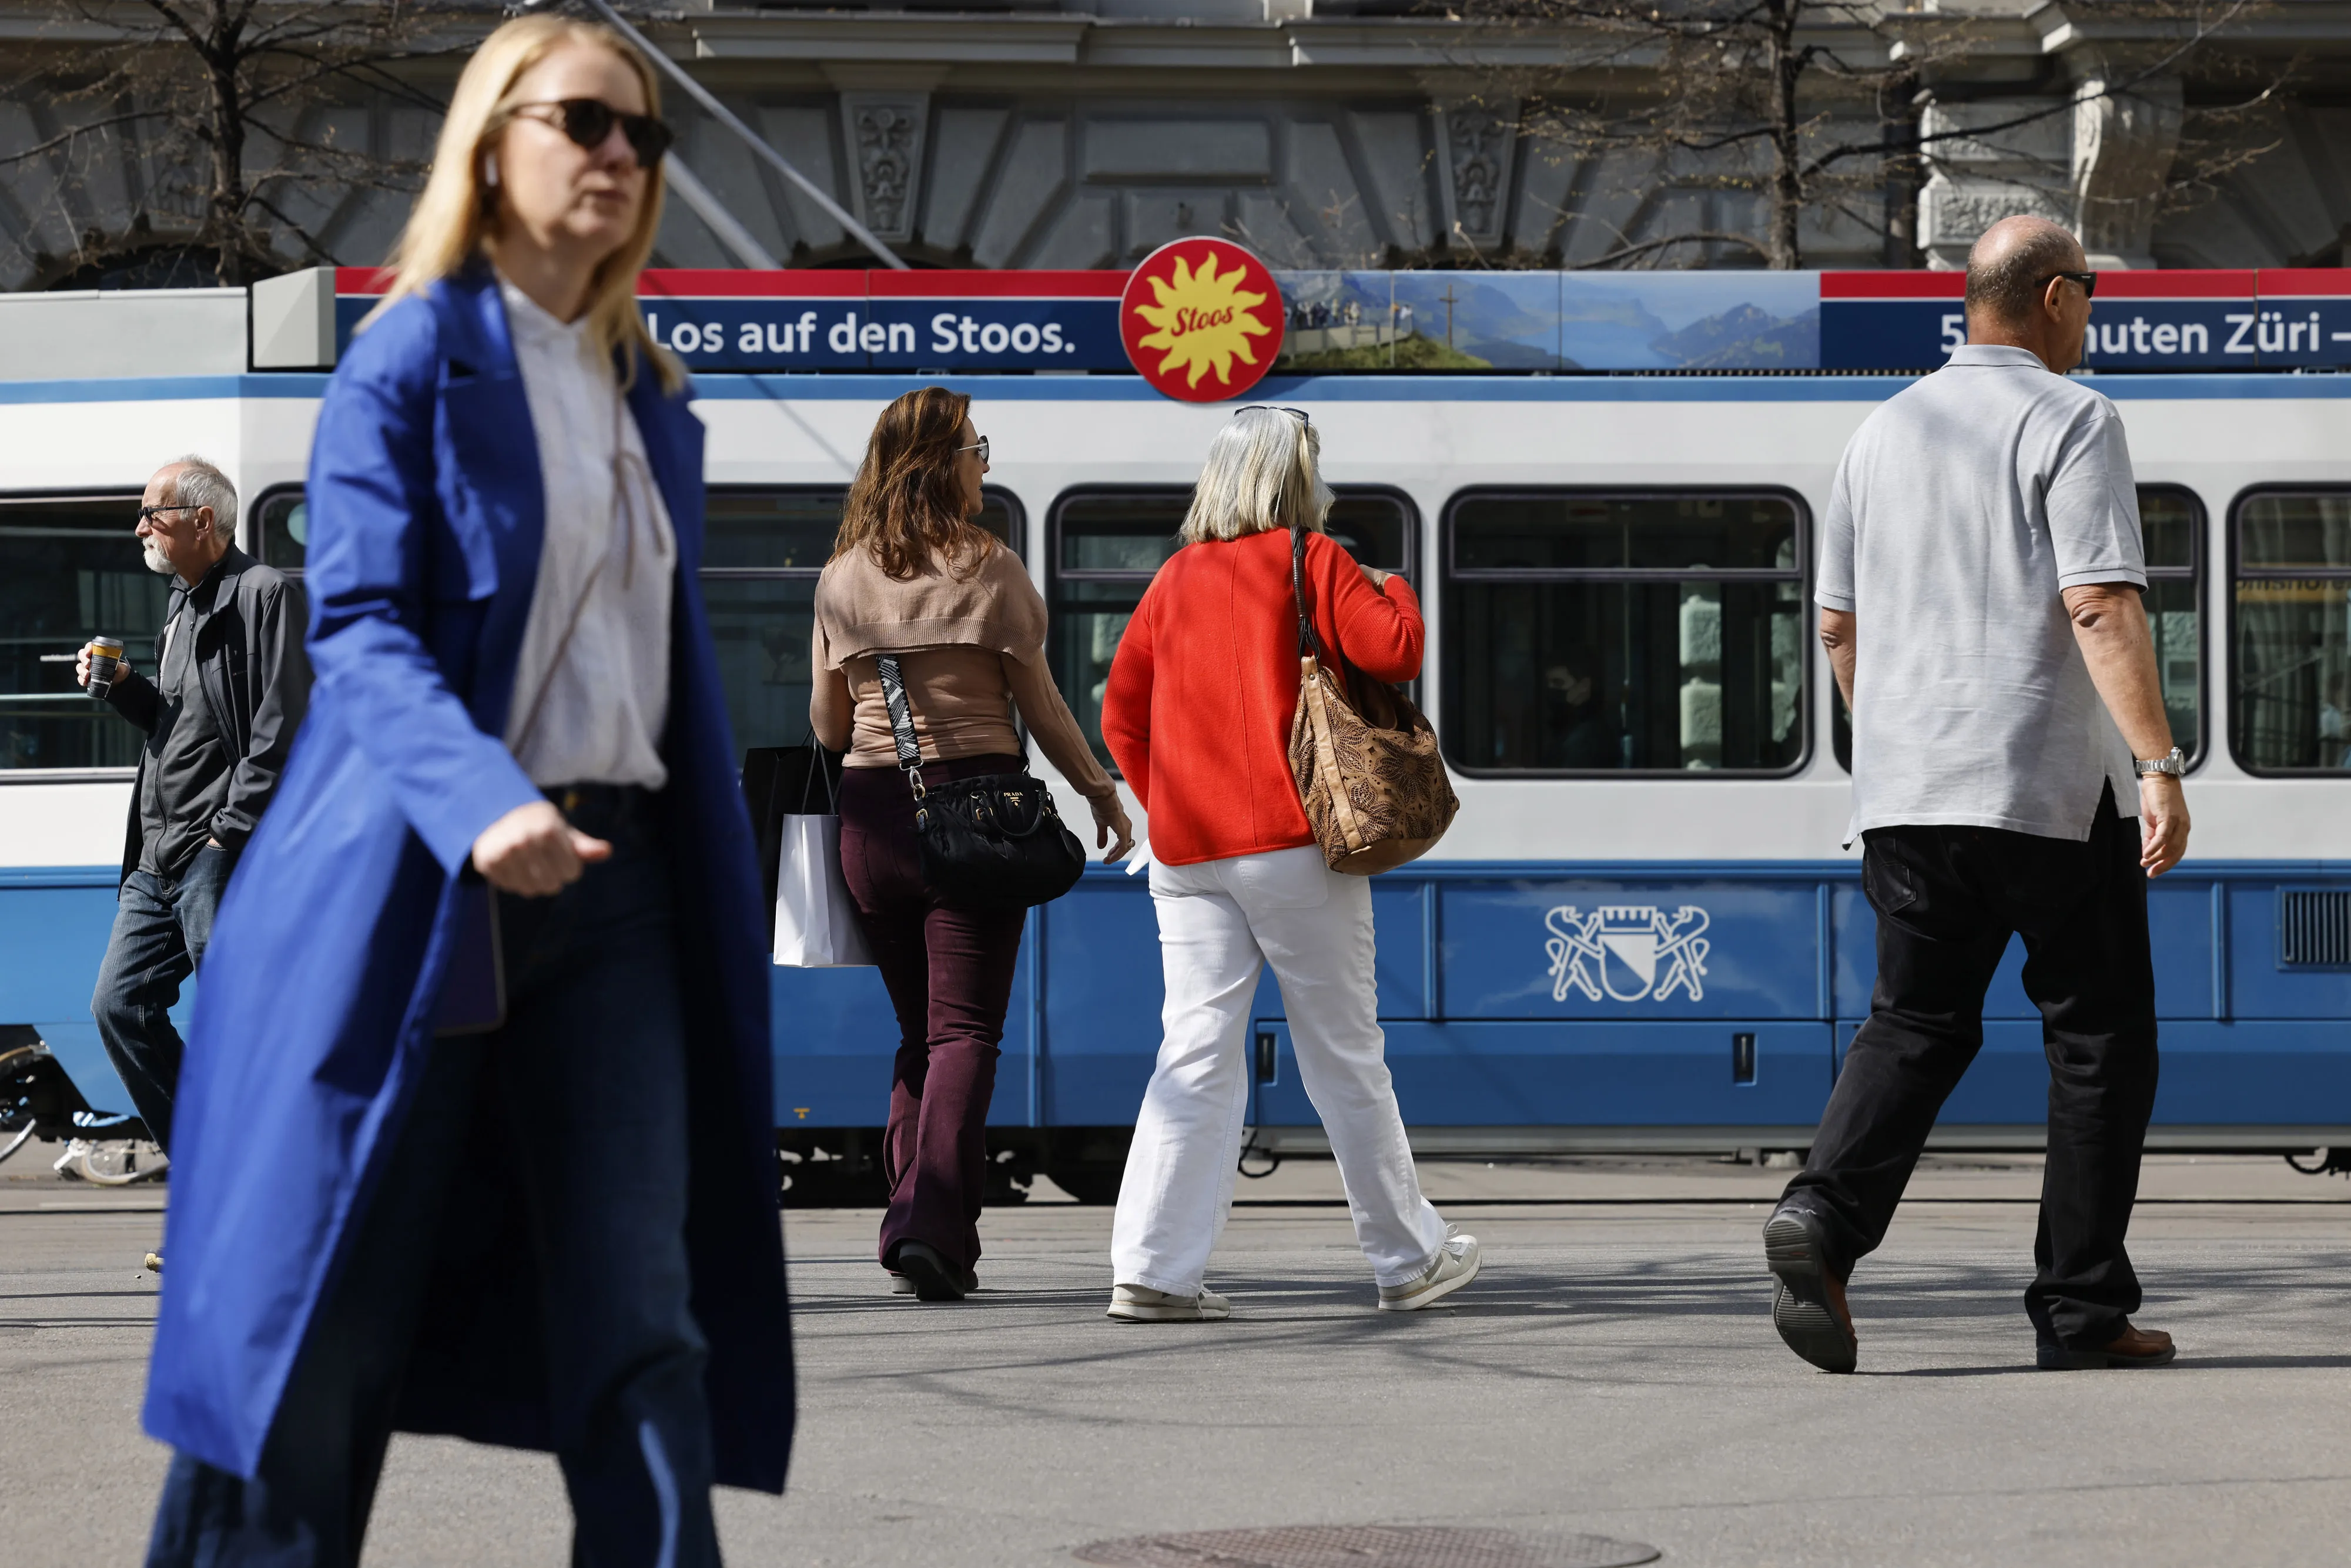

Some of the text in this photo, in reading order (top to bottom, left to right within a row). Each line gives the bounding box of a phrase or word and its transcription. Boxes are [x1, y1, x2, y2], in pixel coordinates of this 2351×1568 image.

[648, 311, 1075, 353] Los auf den Stoos.
[1171, 306, 1234, 337] Stoos
[2223, 311, 2320, 353] Züri
